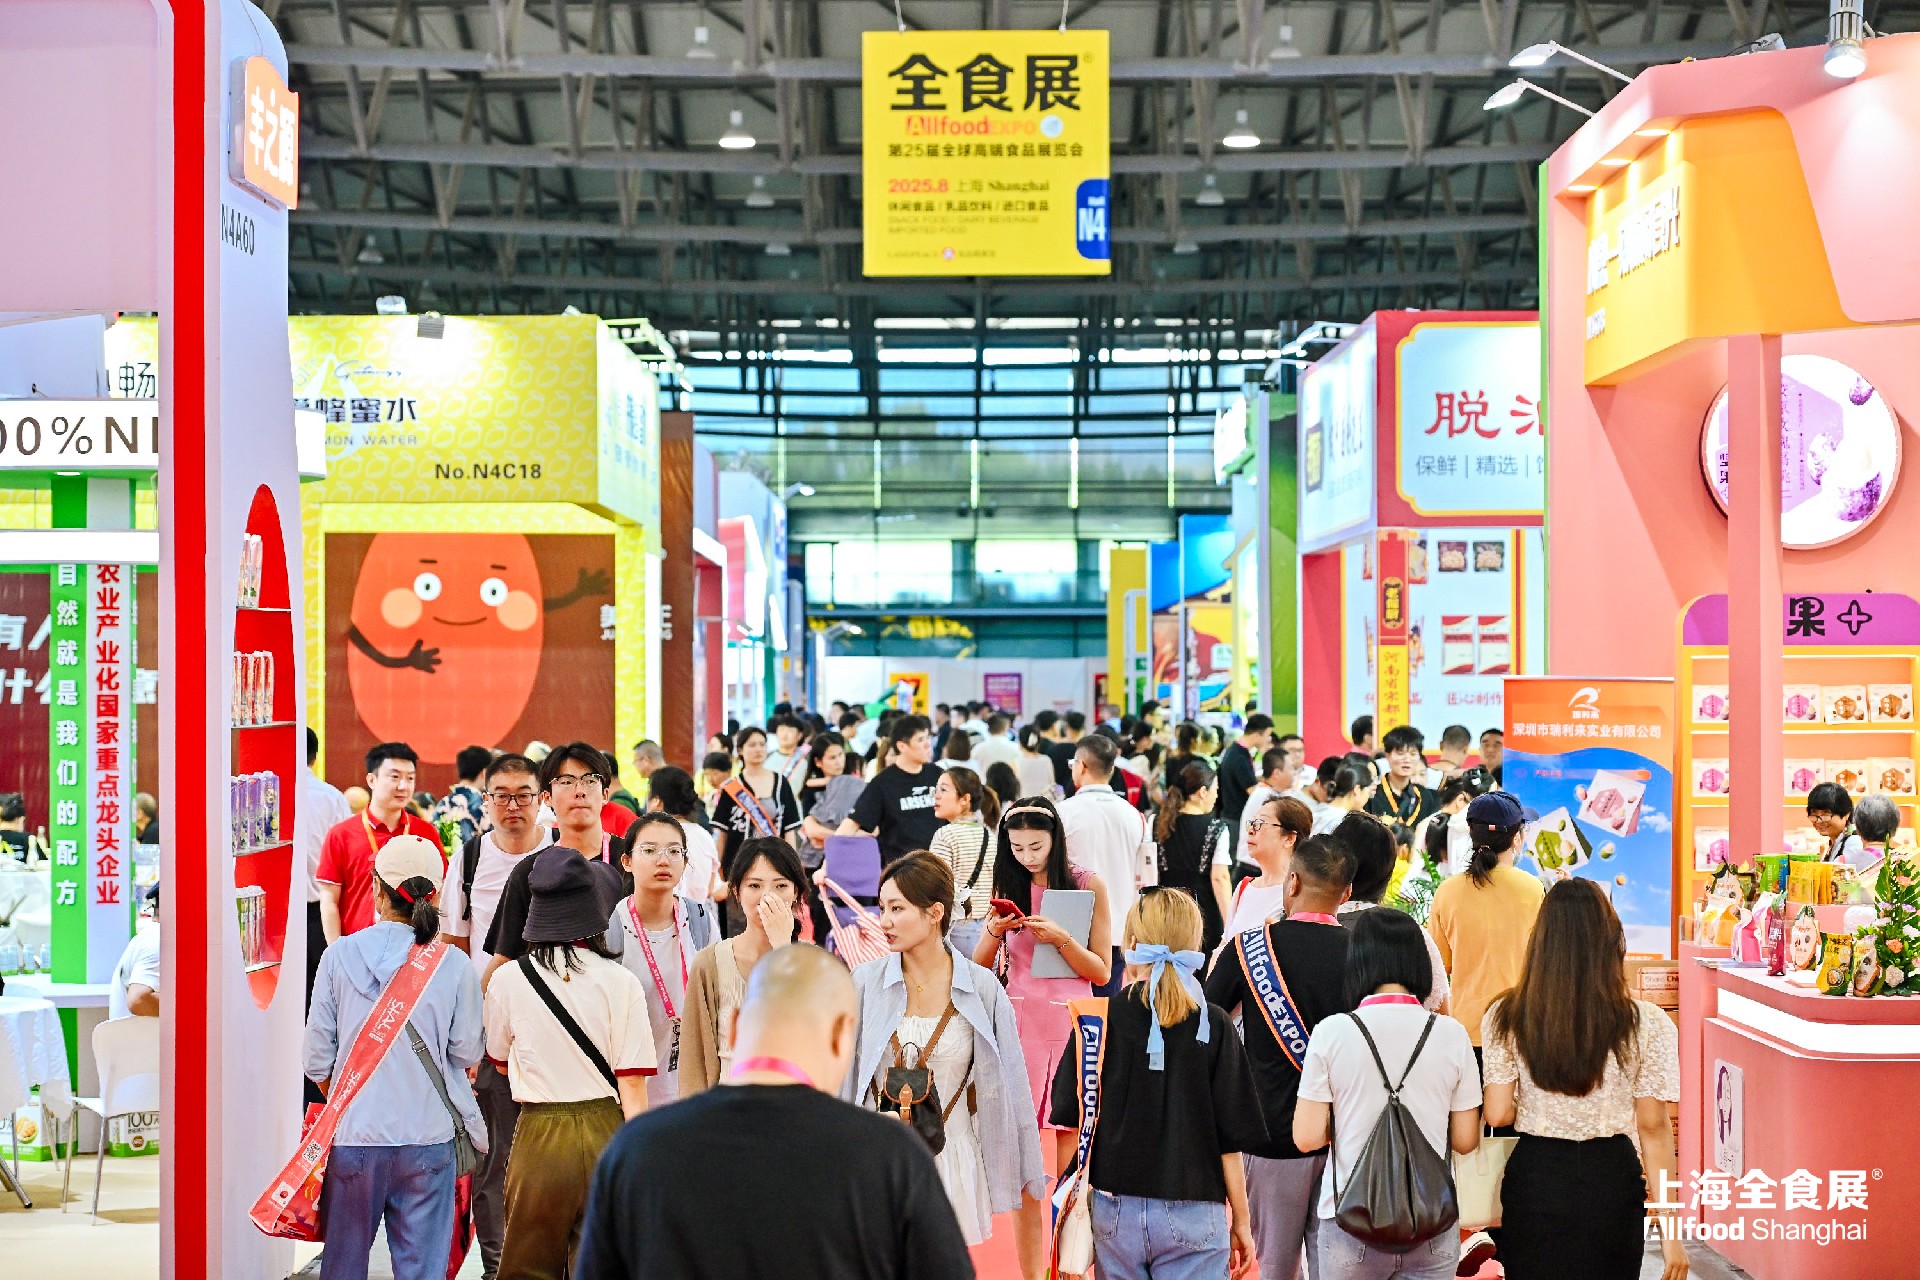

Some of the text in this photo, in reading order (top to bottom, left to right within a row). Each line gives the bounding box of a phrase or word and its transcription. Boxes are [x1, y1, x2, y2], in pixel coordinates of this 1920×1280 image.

[888, 53, 1081, 112] 全食展
[888, 179, 949, 193] 2025.8
[955, 179, 984, 193] 上海
[221, 203, 255, 256] N4A60
[1079, 208, 1106, 241] N4
[106, 361, 156, 398] 畅
[0, 416, 159, 456] 0%N
[362, 434, 417, 445] WATER
[435, 462, 542, 480] No.N4C18
[1415, 455, 1519, 477] 保鲜 精选
[95, 564, 121, 905] 农业产业化国家重点龙头企业
[1512, 722, 1662, 739] 深圳市瑞利来实业有限公司
